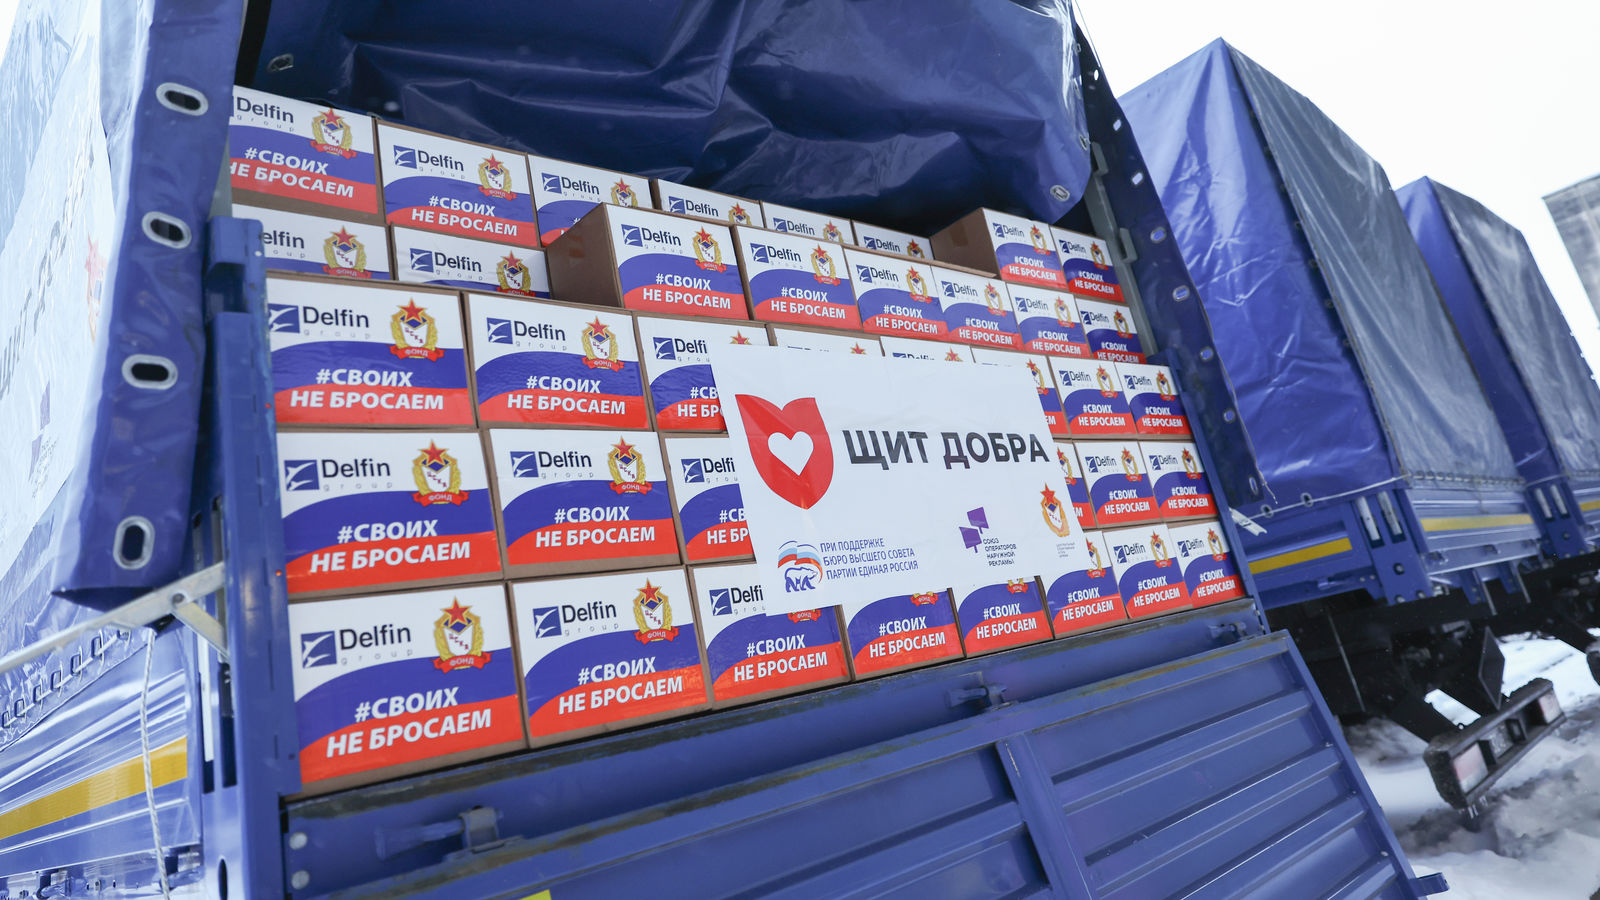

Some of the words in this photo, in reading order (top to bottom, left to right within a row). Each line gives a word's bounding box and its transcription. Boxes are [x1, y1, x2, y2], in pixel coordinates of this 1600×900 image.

[236, 97, 296, 124] Delfin
[244, 146, 330, 176] #СВОИХ
[419, 151, 464, 171] Delfin
[255, 167, 355, 198] БРОСАЕМ
[562, 177, 599, 194] Delfin
[429, 196, 496, 217] #СВОИХ
[686, 200, 719, 217] Delfin
[411, 209, 435, 224] НЕ
[439, 213, 517, 236] БРОСАЕМ
[787, 221, 815, 235] Delfin
[263, 230, 304, 248] elfin
[642, 228, 682, 246] Delfin
[876, 239, 900, 252] Delfin
[435, 252, 481, 272] Delfin
[768, 247, 802, 262] Delfin
[1014, 255, 1044, 268] #СВОИХ
[871, 268, 898, 282] Delfin
[1009, 264, 1020, 274] НЕ
[1021, 267, 1056, 280] БРОСАЕМ
[1078, 270, 1103, 282] #СВОИХ
[656, 273, 711, 291] #СВОИХ
[1074, 279, 1083, 288] НЕ
[1084, 281, 1114, 294] БРОСАЕМ
[643, 288, 662, 302] НЕ
[666, 290, 731, 309] БРОСАЕМ
[782, 287, 828, 302] #СВОИХ
[302, 307, 370, 328] Delfin
[771, 300, 787, 312] НЕ
[790, 302, 845, 319] БРОСАЕМ
[884, 304, 922, 318] #СВОИХ
[515, 321, 566, 341] Delfin
[876, 317, 890, 328] НЕ
[892, 319, 937, 333] БРОСАЕМ
[966, 317, 999, 330] #СВОИХ
[959, 328, 971, 339] НЕ
[972, 330, 1012, 344] БРОСАЕМ
[1038, 330, 1069, 342] #СВОИХ
[674, 338, 707, 353] Delfi
[1032, 341, 1043, 350] НЕ
[1044, 342, 1081, 354] БРОСАЕМ
[1101, 342, 1128, 352] #СВОИХ
[1097, 352, 1106, 360] НЕ
[1107, 353, 1138, 363] БРОСАЕМ
[317, 368, 414, 386] #СВОИХ
[527, 375, 601, 394] #СВОИХ
[290, 390, 325, 407] НЕ
[330, 391, 444, 409] БРОСАЕМ
[691, 387, 717, 399] #СВ
[508, 394, 534, 410] НЕ
[538, 396, 626, 414] БРОСАЕМ
[678, 404, 697, 417] НЕ
[1082, 404, 1112, 413] #СВОИХ
[1145, 407, 1172, 415] #СВОИХ
[1078, 416, 1088, 425] НЕ
[1089, 416, 1124, 425] БРОСАЕМ
[1142, 418, 1151, 426] НЕ
[1152, 418, 1182, 427] БРОСАЕМ
[842, 430, 928, 470] ЩИТ
[941, 432, 1050, 469] ДОБРА
[538, 451, 592, 468] Delfin
[703, 458, 735, 473] Delfi
[322, 459, 390, 478] Delfin
[1108, 489, 1137, 500] #СВОИХ
[1171, 486, 1197, 495] #СВОИХ
[1104, 504, 1115, 514] НЕ
[1115, 502, 1150, 513] БРОСАЕМ
[1167, 499, 1177, 508] НЕ
[1177, 498, 1208, 508] БРОСАЕМ
[554, 506, 629, 523] #СВОИХ
[720, 508, 745, 523] #СВ
[338, 519, 438, 543] #СВОИХ
[536, 530, 561, 547] НЕ
[567, 527, 655, 546] БРОСАЕМ
[707, 530, 726, 544] НЕ
[820, 542, 836, 552] ПРИ
[838, 538, 884, 551] ПОДДЕРЖКЕ
[310, 550, 347, 573] НЕ
[353, 542, 470, 569] БРОСАЕМ
[823, 555, 848, 566] БЮРО
[849, 551, 886, 563] ВЫСШЕГО
[888, 548, 915, 559] СОВЕТА
[826, 568, 857, 580] ПАРТИИ
[859, 564, 888, 577] ЕДИНАЯ
[890, 560, 918, 572] РОССИЯ
[1199, 569, 1224, 582] #СВОИХ
[1137, 576, 1167, 590] #СВОИХ
[1196, 586, 1206, 597] НЕ
[1206, 581, 1235, 595] БРОСАЕМ
[731, 585, 763, 603] Delfi
[1068, 587, 1100, 604] #СВОИХ
[1133, 594, 1144, 607] НЕ
[1145, 588, 1180, 604] БРОСАЕМ
[562, 601, 616, 624] Delfin
[984, 603, 1021, 620] #СВОИХ
[1063, 609, 1075, 621] НЕ
[1076, 600, 1113, 618] БРОСАЕМ
[879, 616, 927, 637] #СВОИХ
[977, 626, 989, 639] НЕ
[992, 618, 1036, 637] БРОСАЕМ
[340, 624, 412, 650] Delfin
[747, 634, 805, 657] #СВОИХ
[870, 643, 887, 658] НЕ
[890, 632, 946, 654] БРОСАЕМ
[578, 656, 656, 685] #СВОИХ
[734, 664, 754, 682] НЕ
[758, 652, 827, 678] БРОСАЕМ
[559, 691, 586, 714] НЕ
[591, 676, 682, 708] БРОСАЕМ
[355, 687, 459, 722] #СВОИХ
[327, 729, 364, 757] НЕ
[370, 710, 492, 749] БРОСАЕМ
